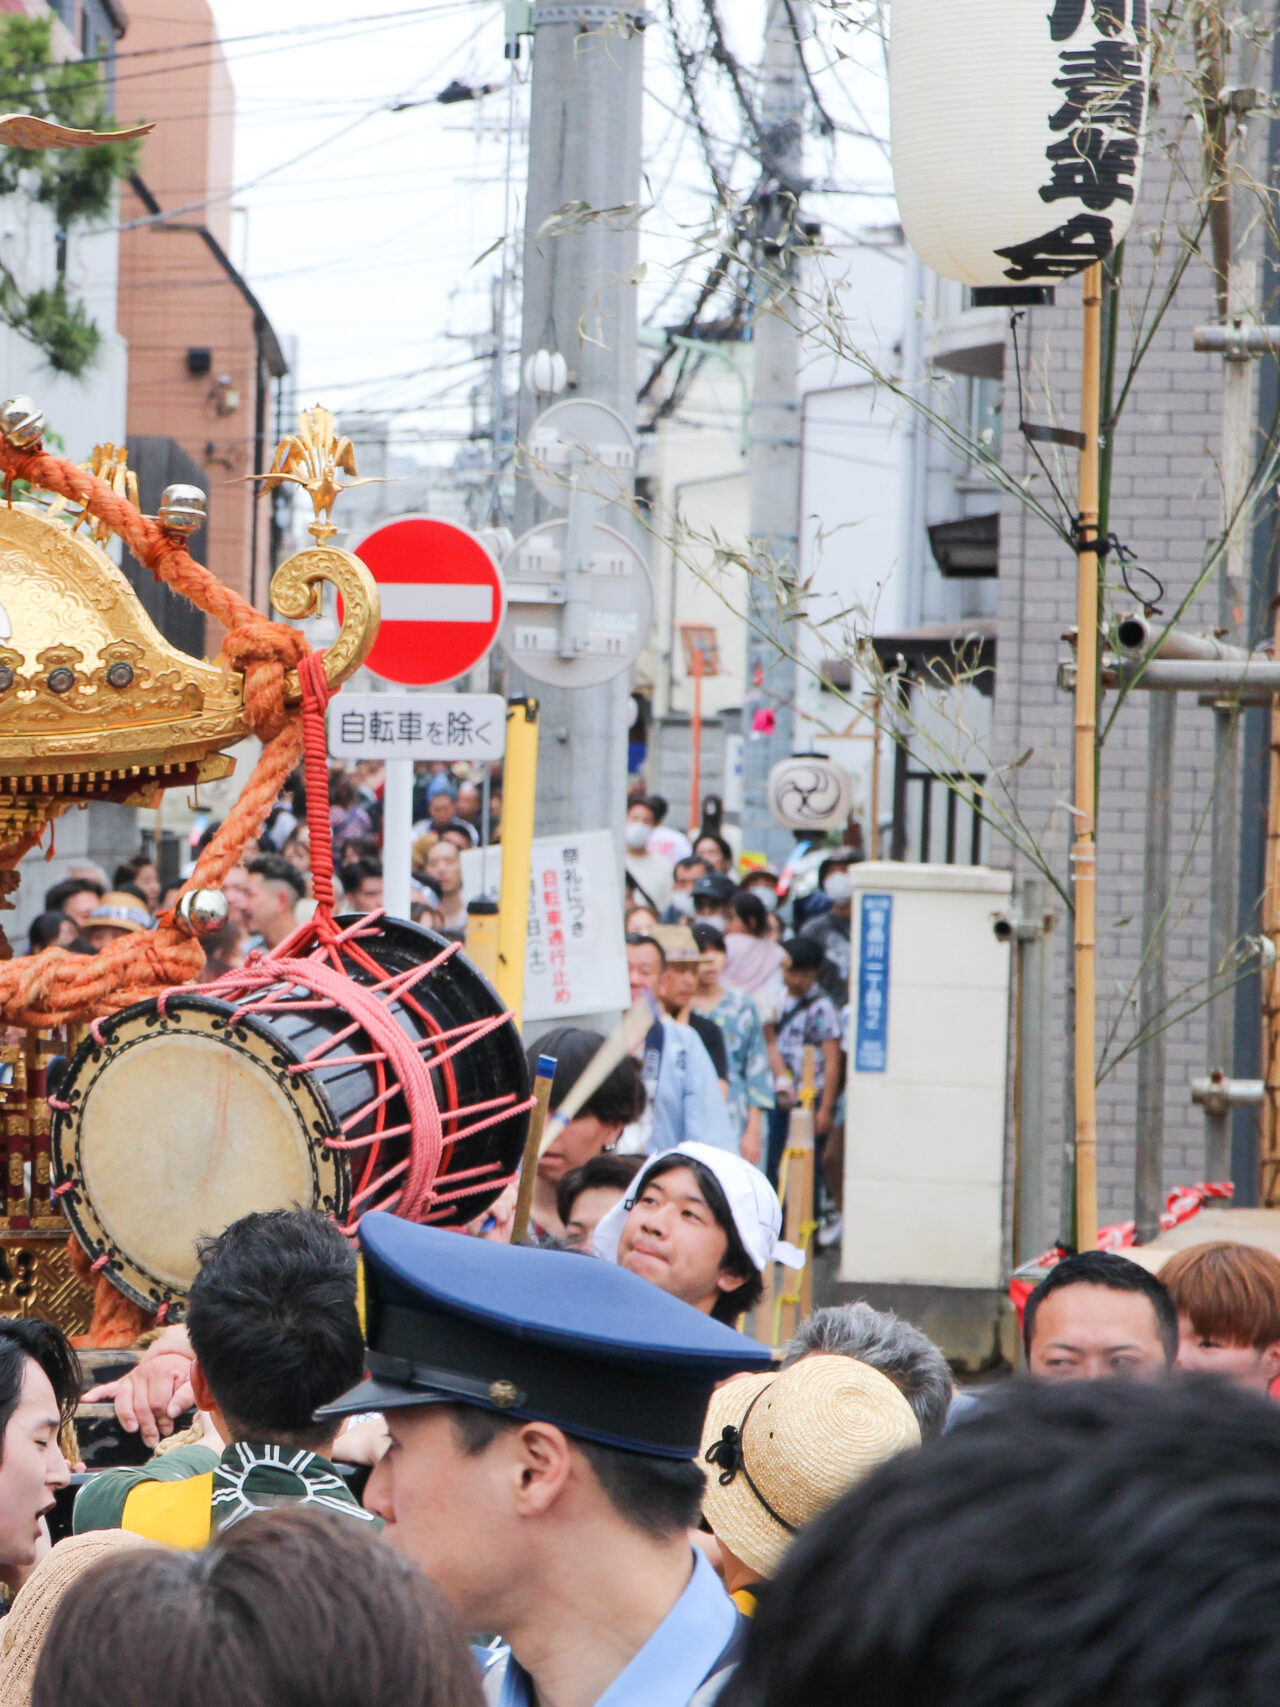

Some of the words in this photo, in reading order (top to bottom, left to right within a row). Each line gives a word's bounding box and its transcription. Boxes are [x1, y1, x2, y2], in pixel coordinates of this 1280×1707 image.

[341, 710, 493, 746] 自転車を除く
[542, 869, 572, 1004] 自転車通行止め
[562, 848, 586, 938] 祭礼につき
